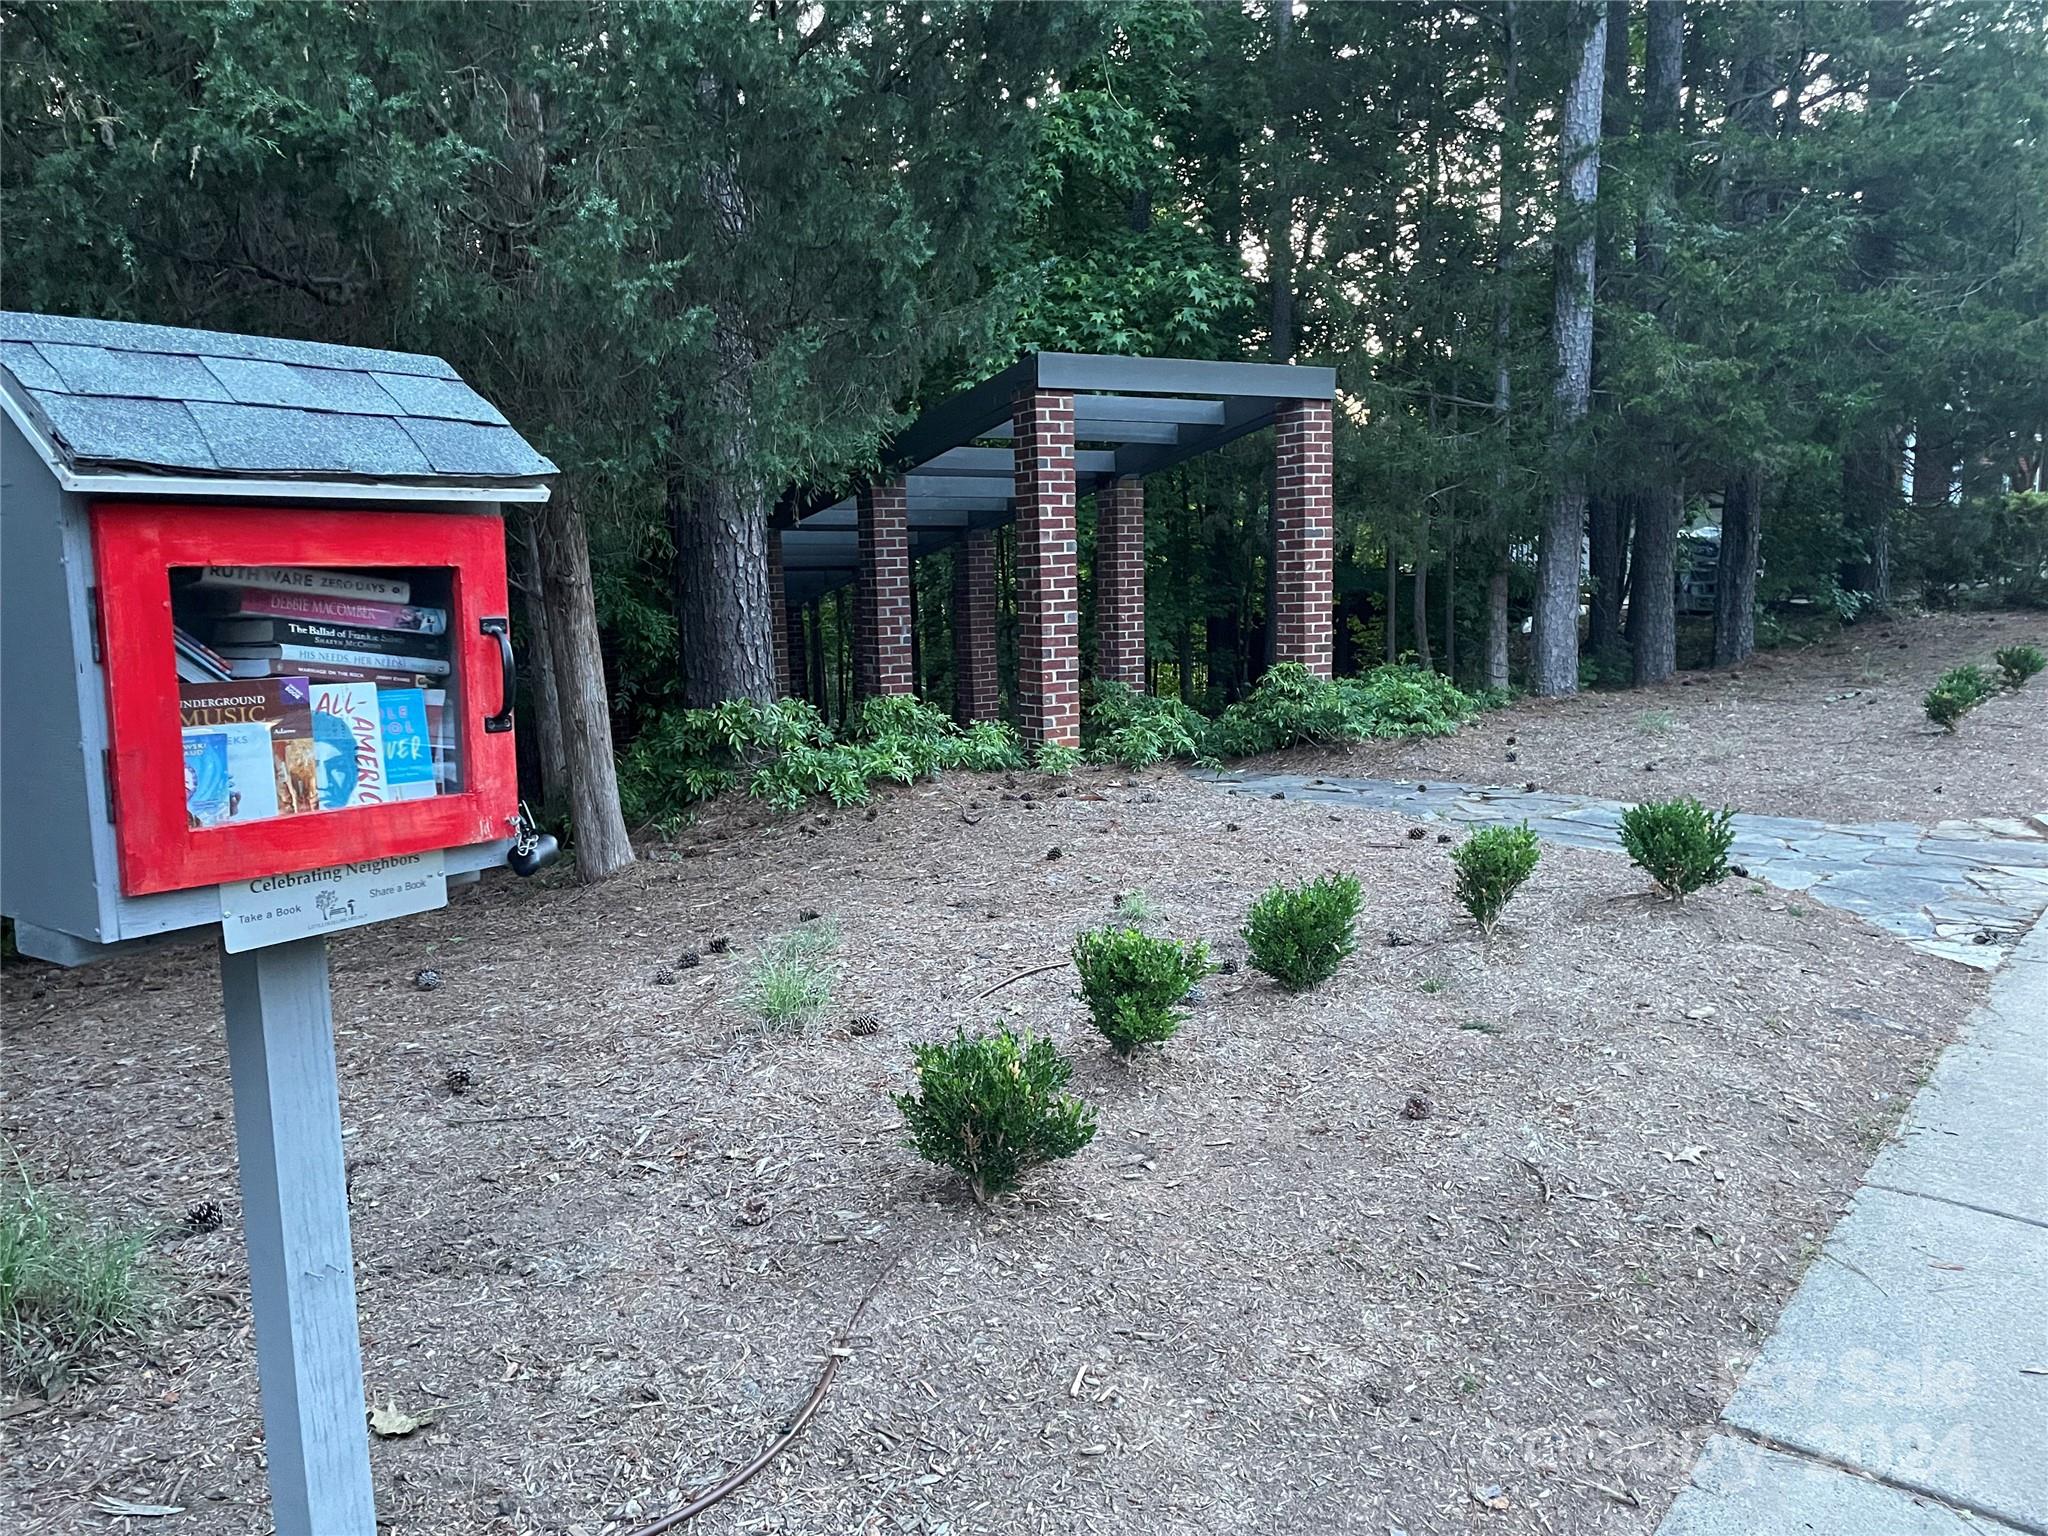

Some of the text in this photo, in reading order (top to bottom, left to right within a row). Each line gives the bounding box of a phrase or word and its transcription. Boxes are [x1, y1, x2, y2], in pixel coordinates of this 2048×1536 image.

[210, 567, 313, 587] RUTH WARE
[321, 577, 385, 593] ZERO DAYS
[271, 594, 376, 620] DEBBIE MACOMBER
[288, 623, 307, 634] The
[309, 625, 335, 637] Ballad
[336, 630, 346, 639] of
[348, 630, 379, 642] Frankie
[300, 650, 316, 659] HIS
[354, 655, 372, 665] HER
[180, 695, 265, 709] NDERGROUND
[181, 705, 266, 726] MUSIC
[250, 854, 421, 894] Celebrating Neighbors
[369, 886, 395, 898] Share
[405, 880, 426, 891] Book
[238, 911, 263, 924] Take
[276, 905, 302, 917] Book
